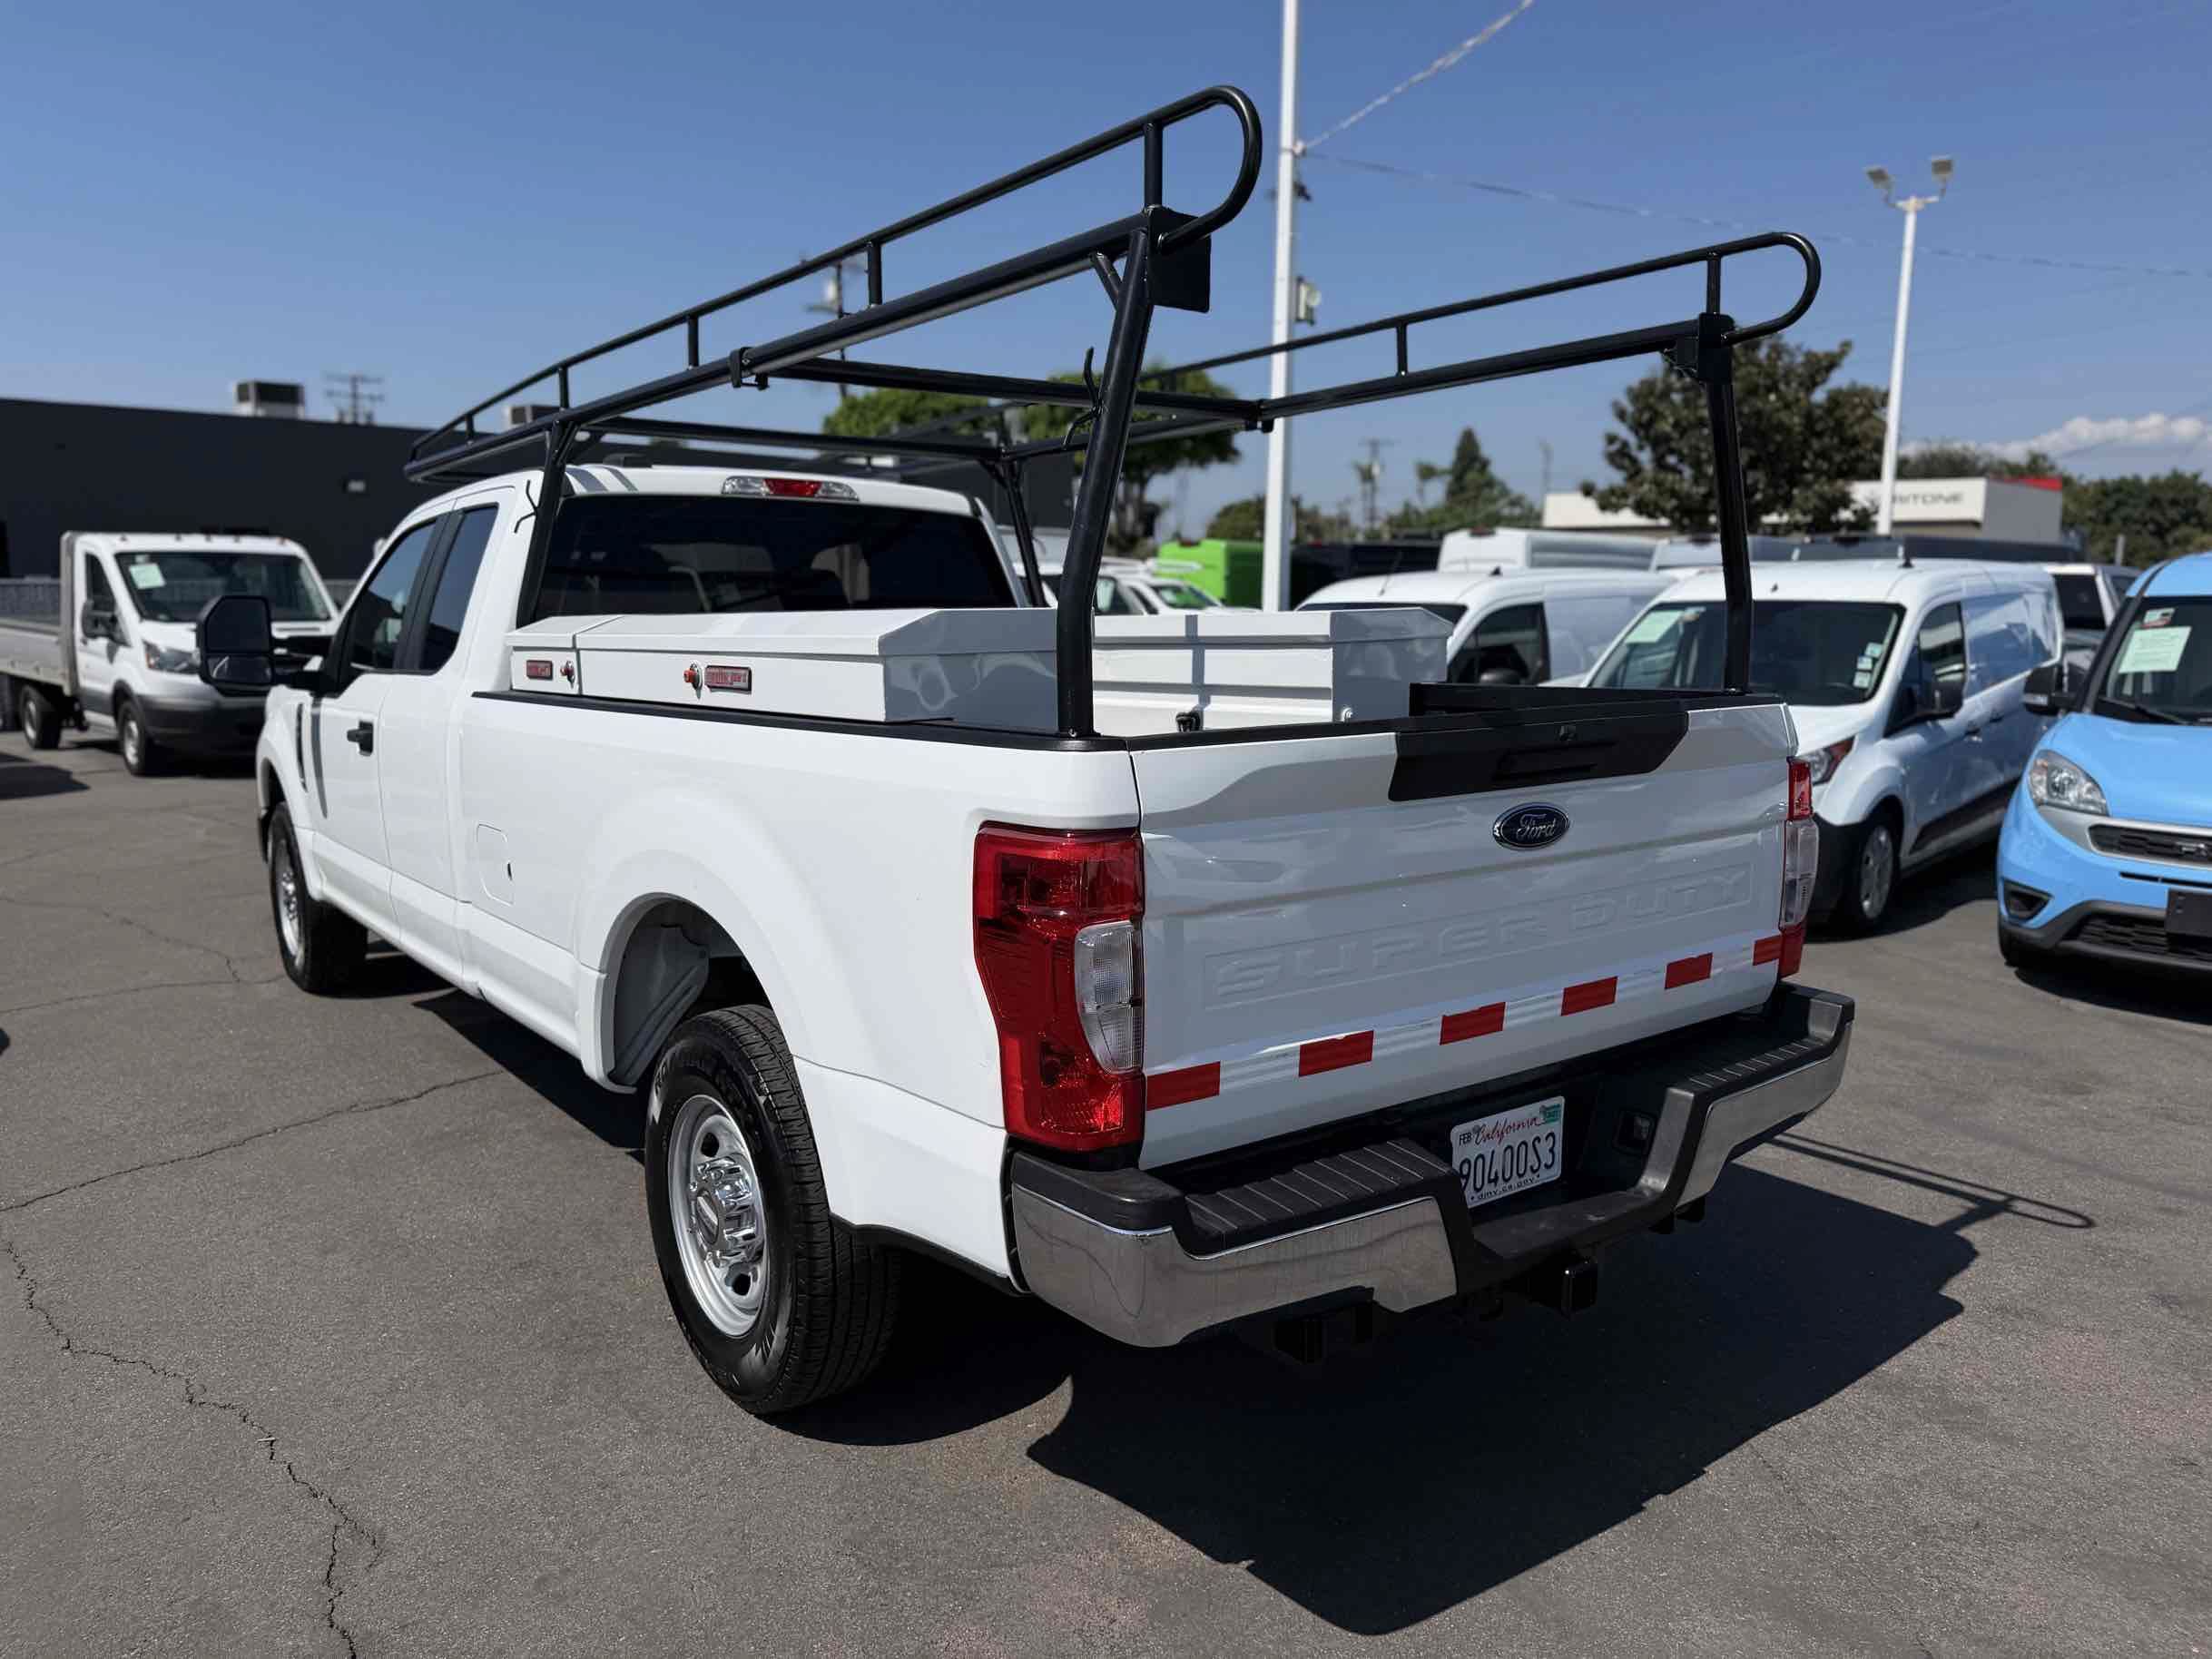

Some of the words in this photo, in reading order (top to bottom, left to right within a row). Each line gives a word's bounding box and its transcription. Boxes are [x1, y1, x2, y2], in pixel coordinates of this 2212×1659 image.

[1516, 813, 1557, 841] Ford
[1214, 912, 1548, 997] SUPER
[1571, 869, 1749, 932] DUTY
[1459, 1131, 1472, 1146] FEB
[1473, 1115, 1543, 1145] California
[1458, 1131, 1556, 1193] 90400S3
